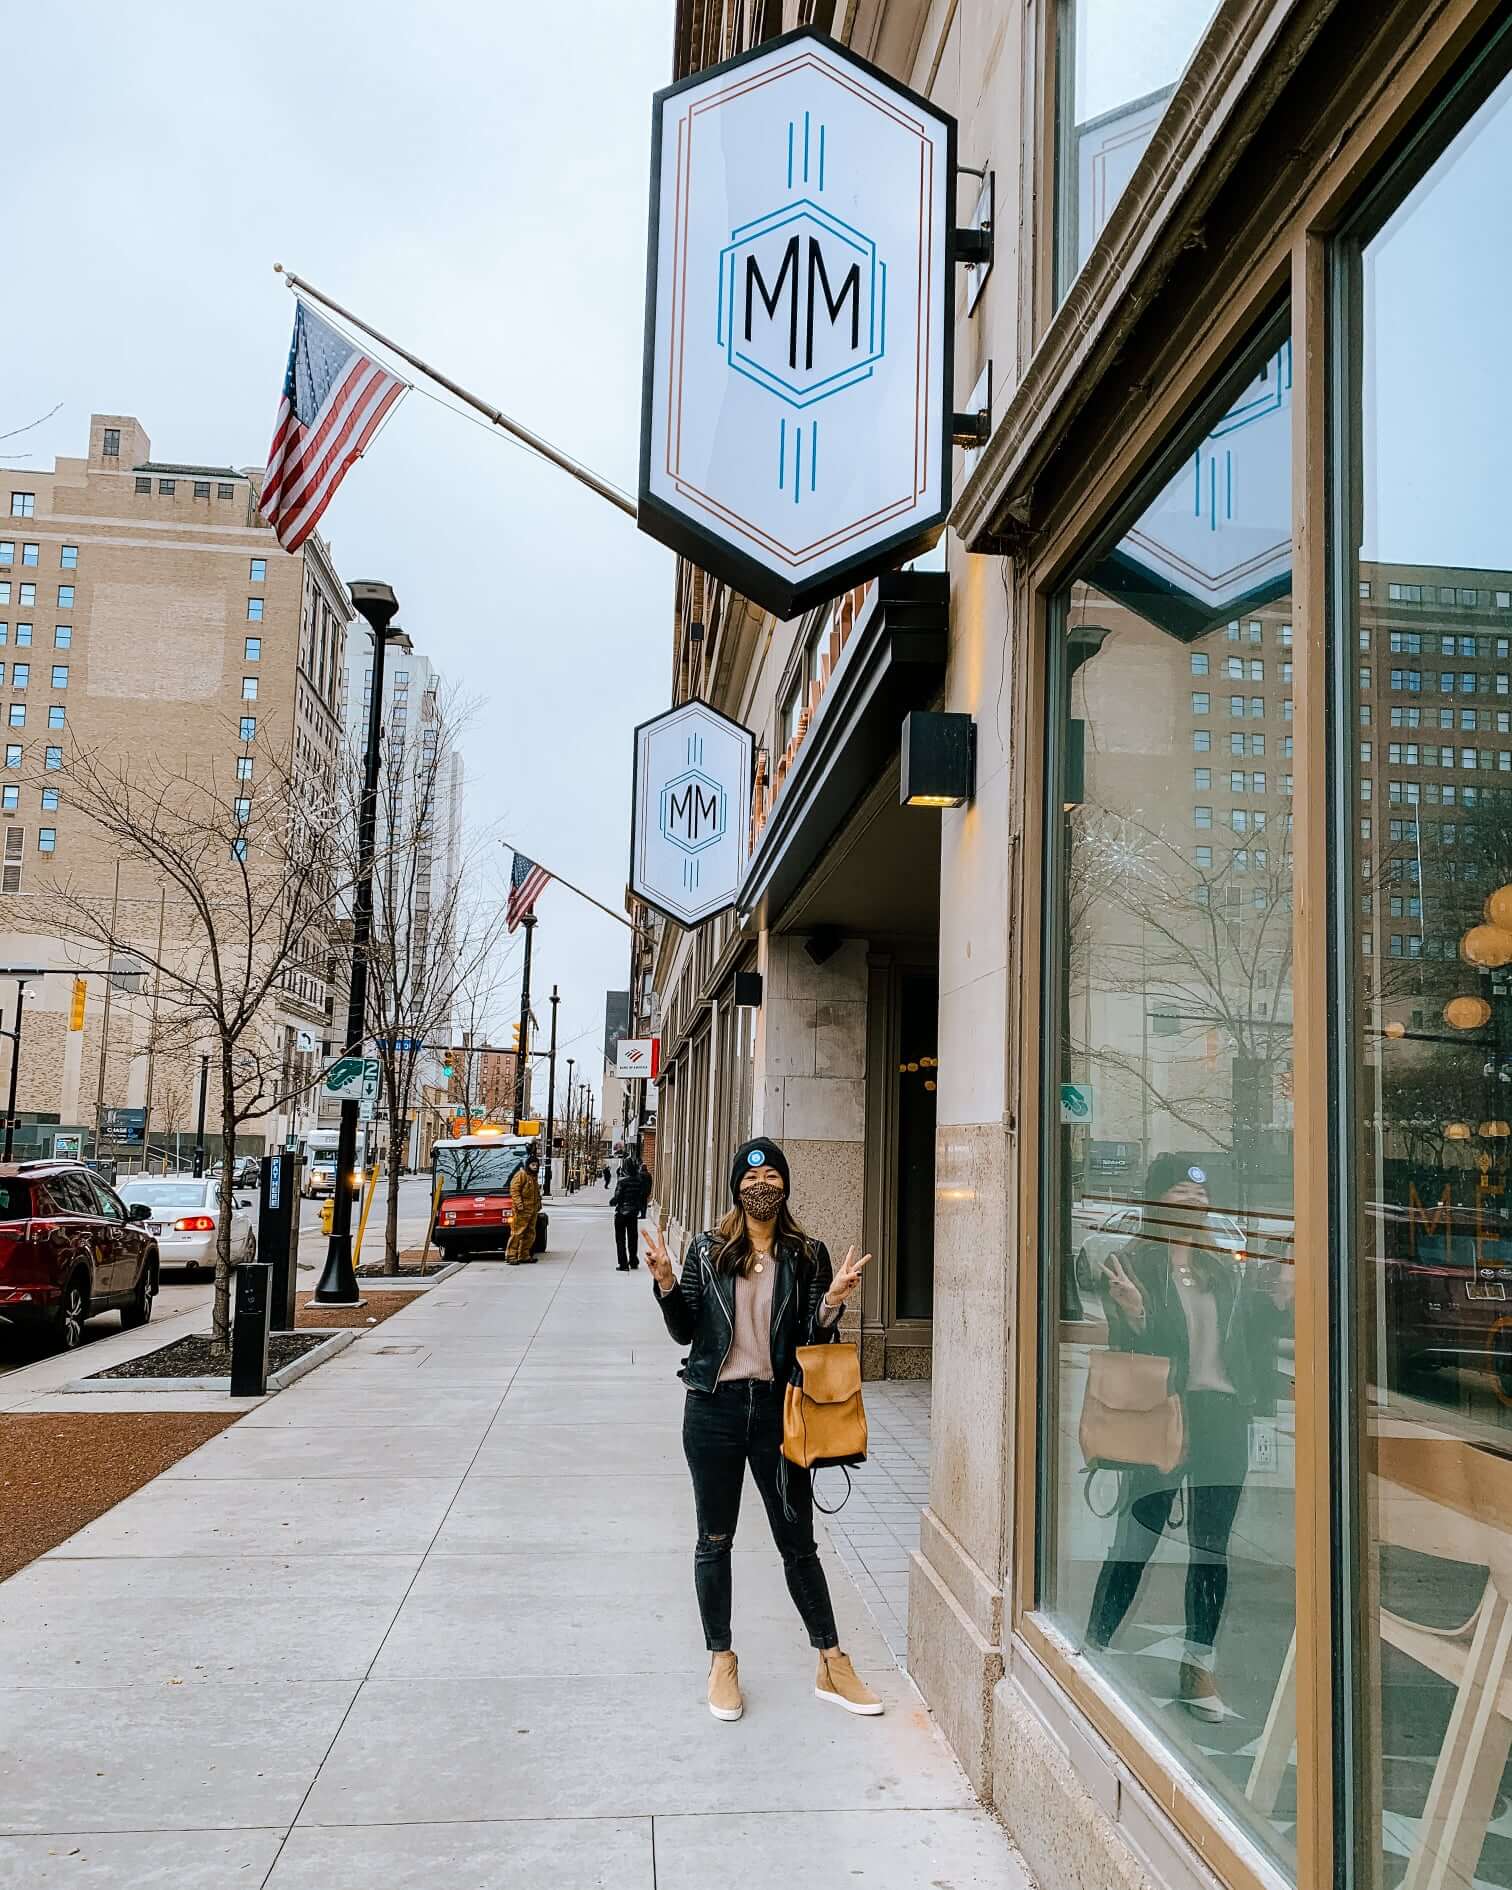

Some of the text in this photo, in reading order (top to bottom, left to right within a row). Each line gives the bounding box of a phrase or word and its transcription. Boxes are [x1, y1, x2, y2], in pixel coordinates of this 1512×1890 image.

[744, 233, 861, 372] MM
[670, 783, 717, 840] MM
[365, 1061, 378, 1076] 2
